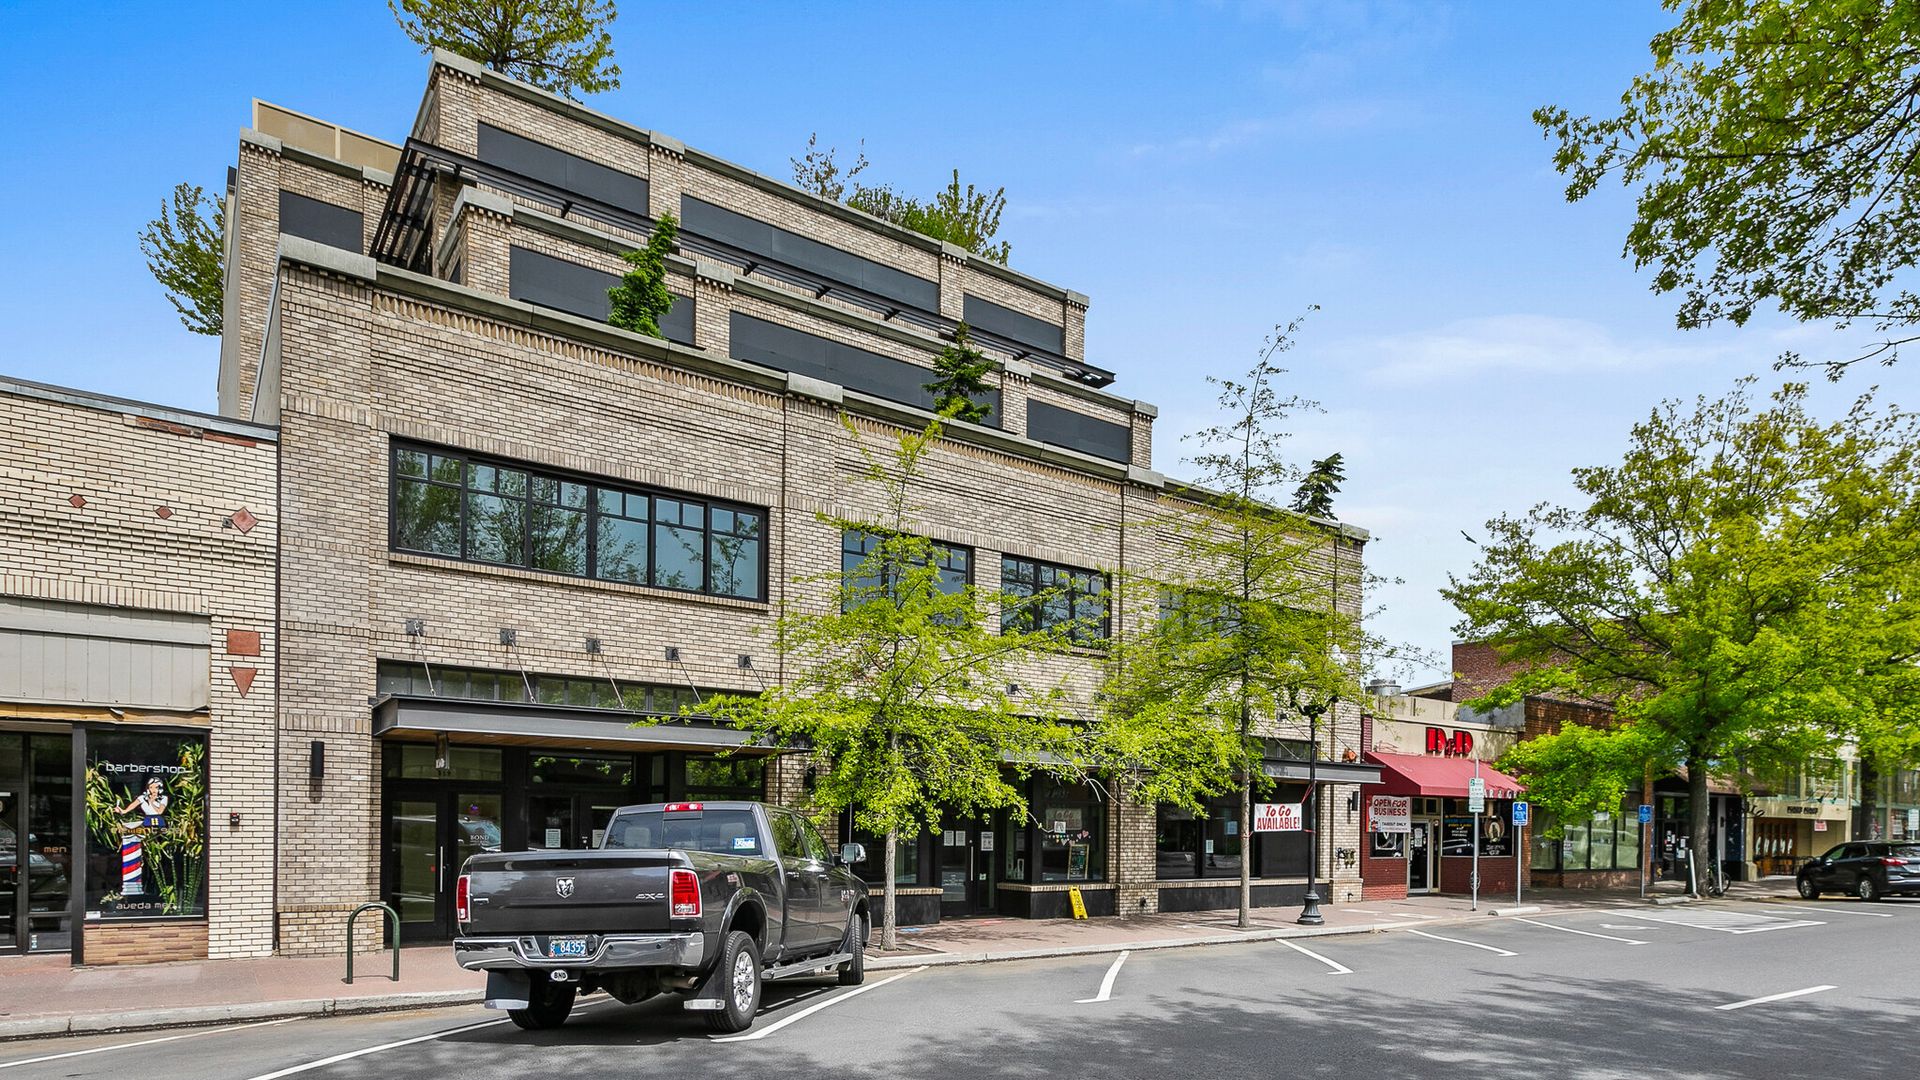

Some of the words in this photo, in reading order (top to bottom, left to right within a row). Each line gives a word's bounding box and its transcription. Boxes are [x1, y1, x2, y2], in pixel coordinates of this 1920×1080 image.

[1425, 726, 1473, 758] D&D
[106, 763, 186, 774] barbershop
[1374, 799, 1391, 807] OPEN
[1392, 800, 1407, 808] FOR
[1265, 805, 1276, 817] To
[1278, 805, 1291, 817] Go
[1374, 808, 1407, 817] BUSINESS
[1256, 817, 1300, 831] AVAILABLE!
[44, 846, 67, 854] men
[560, 940, 586, 953] 84355
